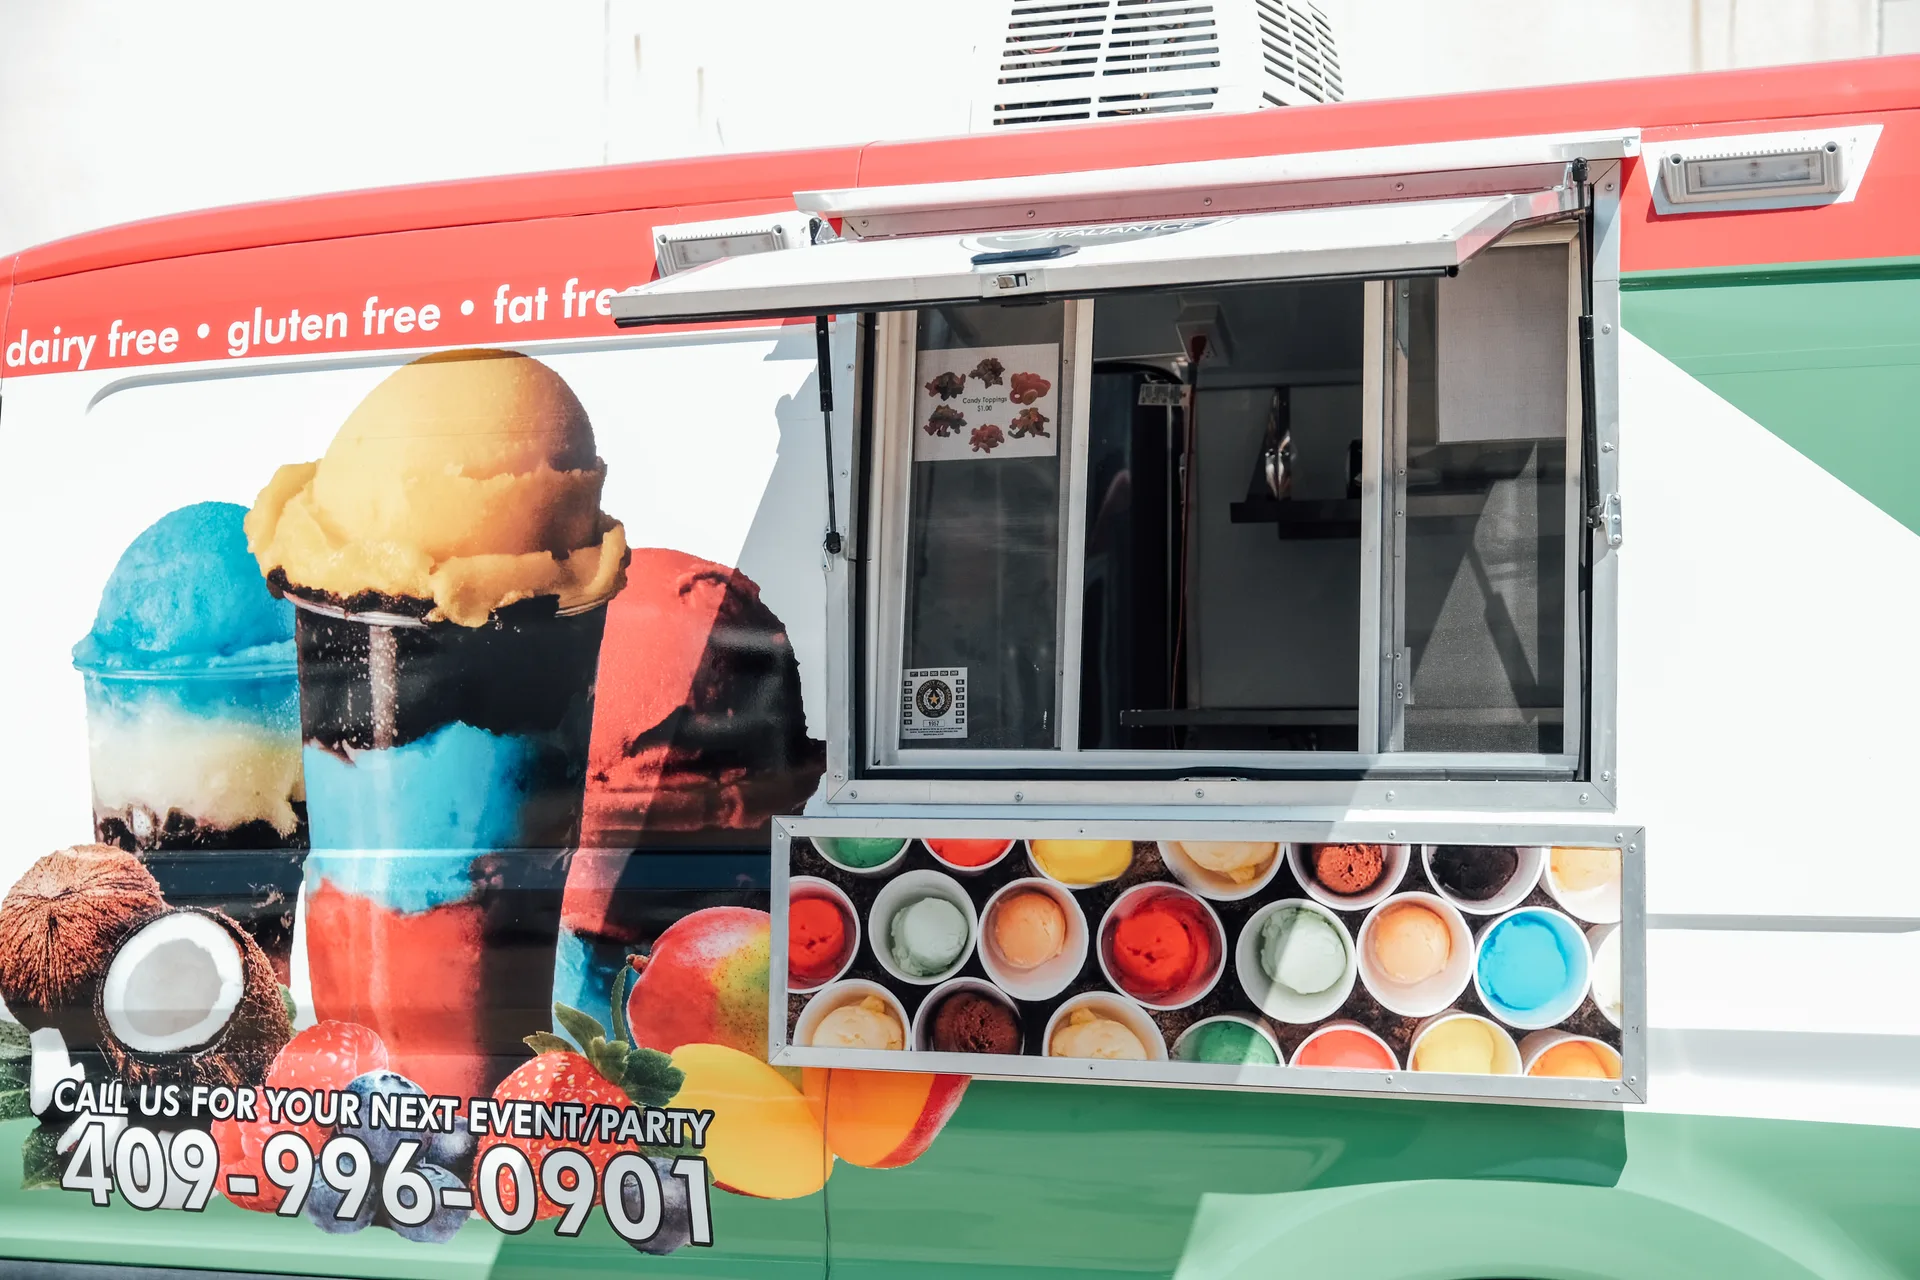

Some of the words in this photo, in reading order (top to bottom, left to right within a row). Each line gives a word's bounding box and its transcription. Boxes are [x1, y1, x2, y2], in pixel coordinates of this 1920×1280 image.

[6, 326, 97, 370] dairy
[108, 319, 179, 356] free
[227, 306, 348, 356] gluten
[362, 296, 441, 335] free
[493, 284, 548, 324] fat
[561, 277, 640, 319] fre
[962, 397, 981, 405] Candy
[983, 396, 1008, 405] Toppings
[977, 405, 993, 413] $1.00
[53, 1079, 130, 1116] CALL
[138, 1083, 181, 1118] US
[190, 1085, 258, 1121] FOR
[265, 1088, 362, 1127] YOUR
[370, 1093, 461, 1132] NEXT
[469, 1099, 714, 1147] EVENT/PARTY
[61, 1121, 714, 1247] 409-996-0901
